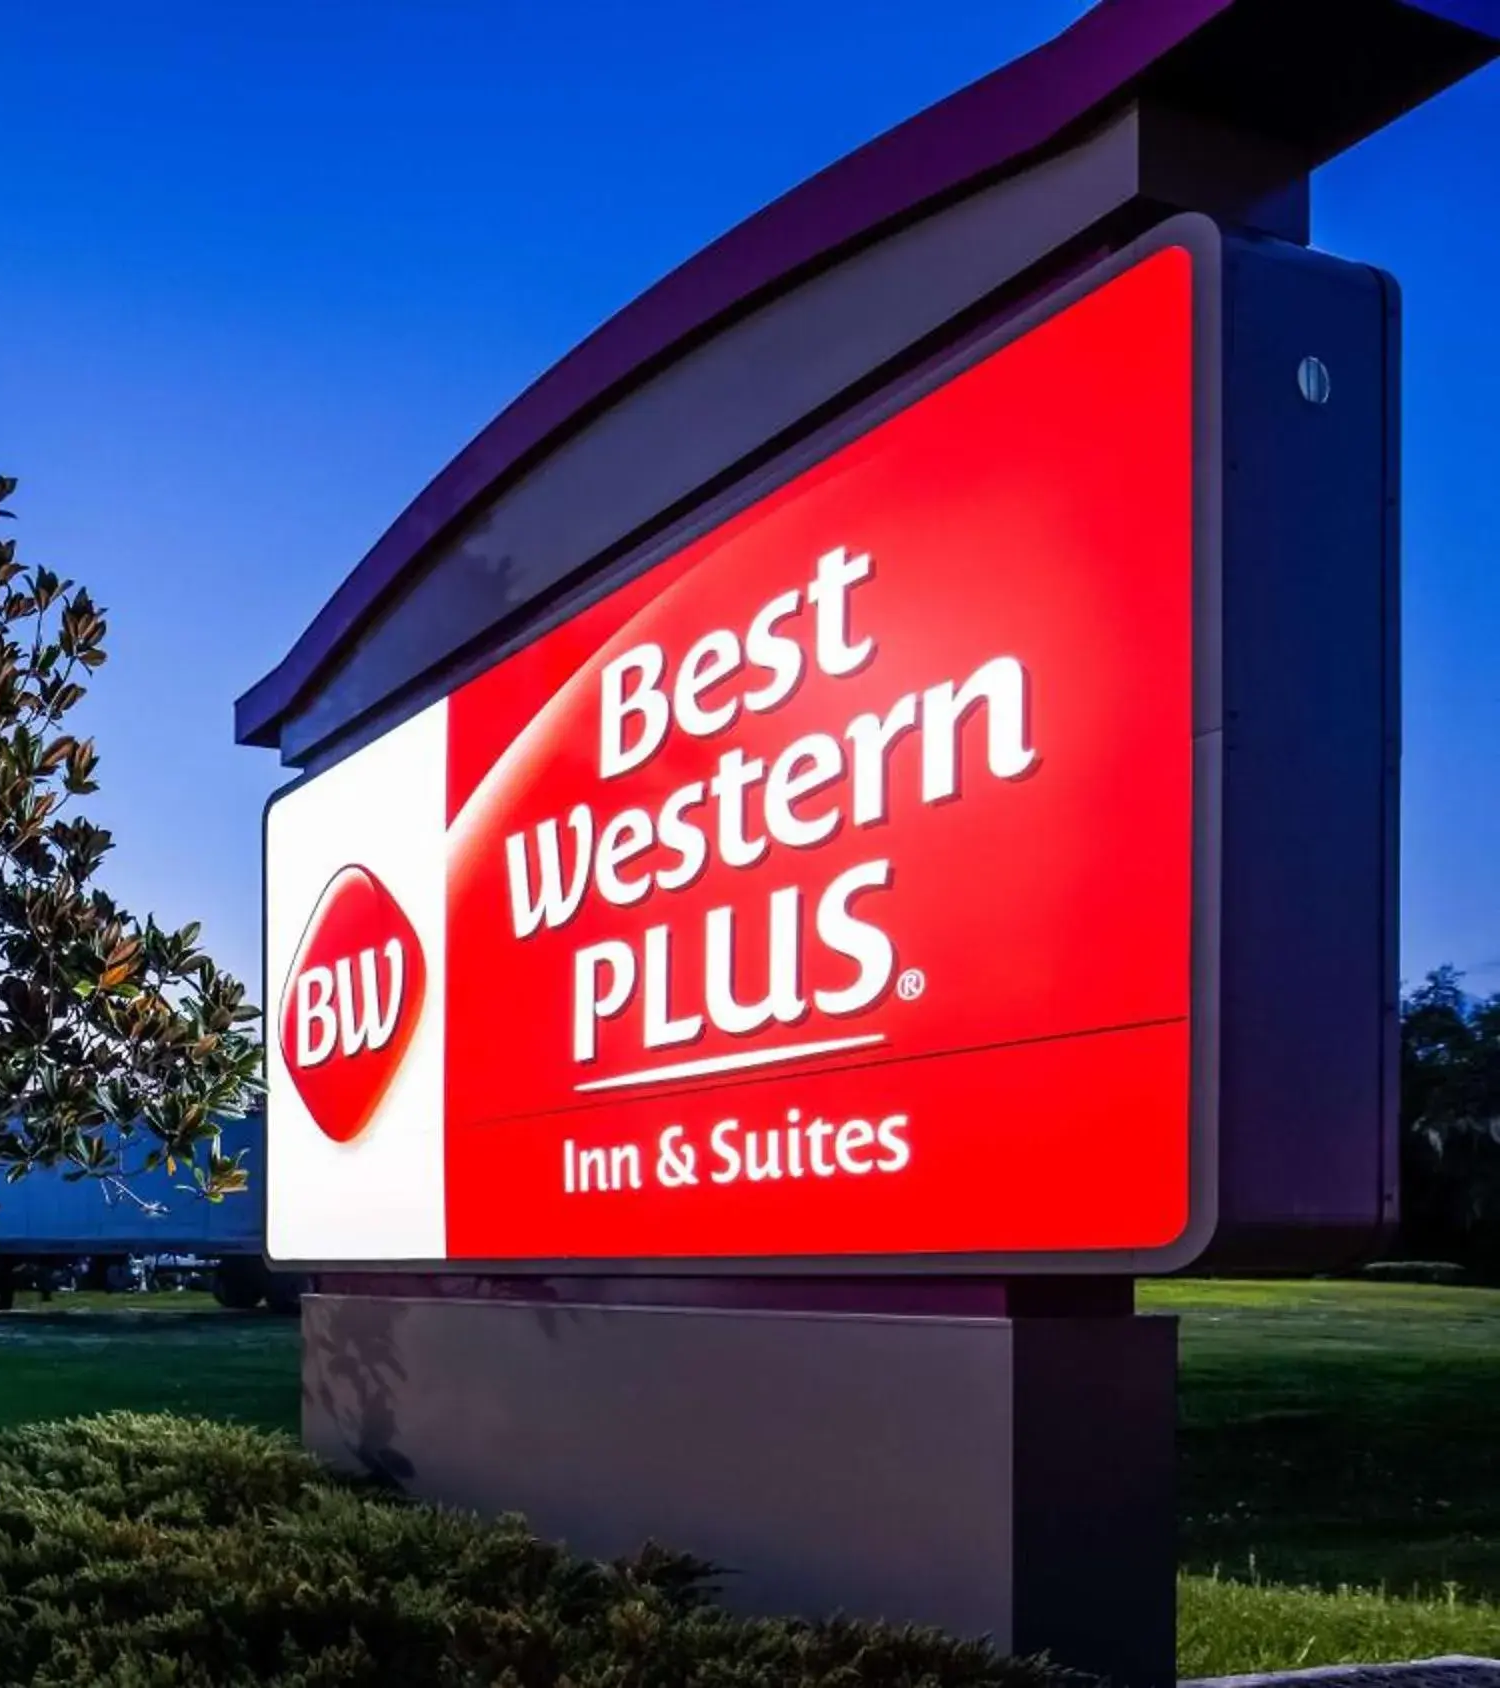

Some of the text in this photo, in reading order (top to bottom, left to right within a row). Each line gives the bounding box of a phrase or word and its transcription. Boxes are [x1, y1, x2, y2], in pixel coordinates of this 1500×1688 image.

[600, 546, 873, 779] Best
[505, 655, 1036, 938] Western
[296, 938, 404, 1068] BW
[564, 1108, 910, 1194] Inn & Suites
